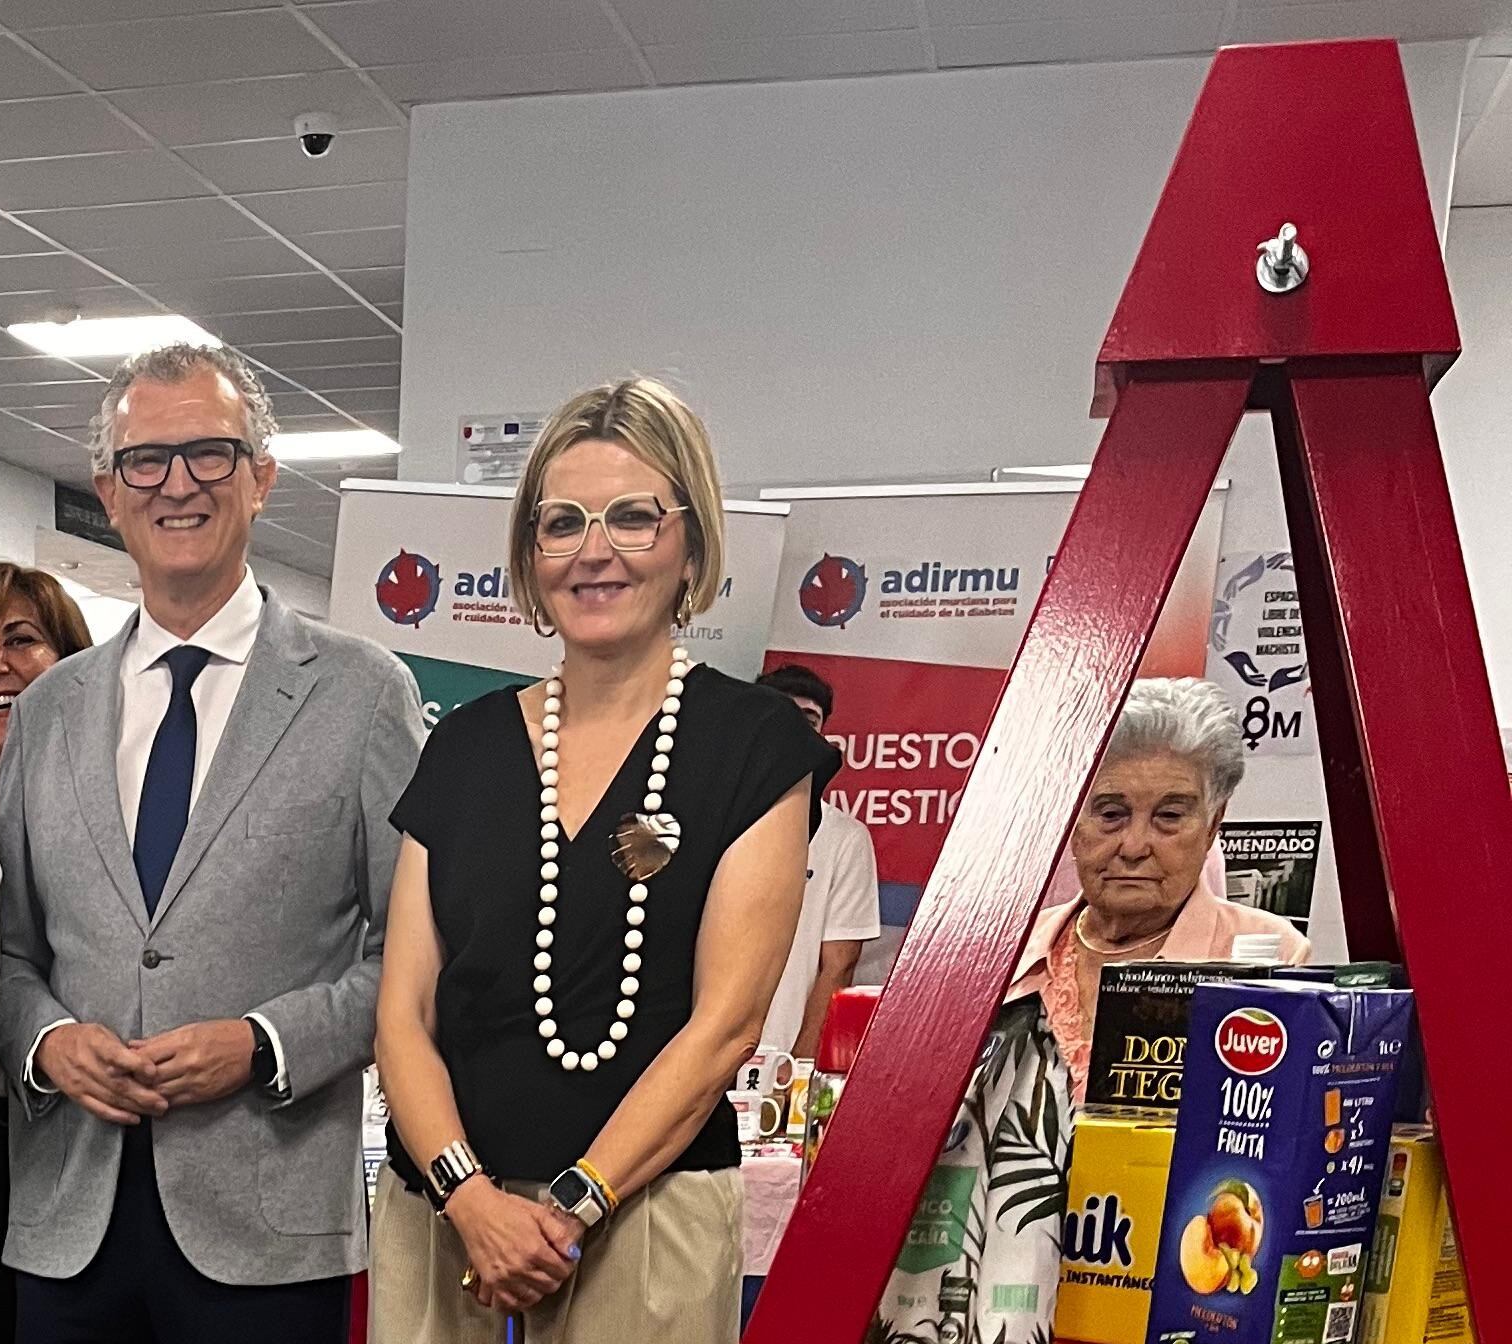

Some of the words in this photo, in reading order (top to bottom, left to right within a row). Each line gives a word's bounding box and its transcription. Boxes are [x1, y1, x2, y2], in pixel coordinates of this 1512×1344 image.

[881, 562, 1020, 594] adirmu
[465, 613, 506, 624] cuidado
[509, 616, 522, 625] de
[892, 607, 937, 618] cuidado
[939, 608, 953, 617] de
[1223, 1026, 1280, 1058] Juver
[1220, 1077, 1273, 1120] 100%
[1217, 1126, 1266, 1161] FRUTA
